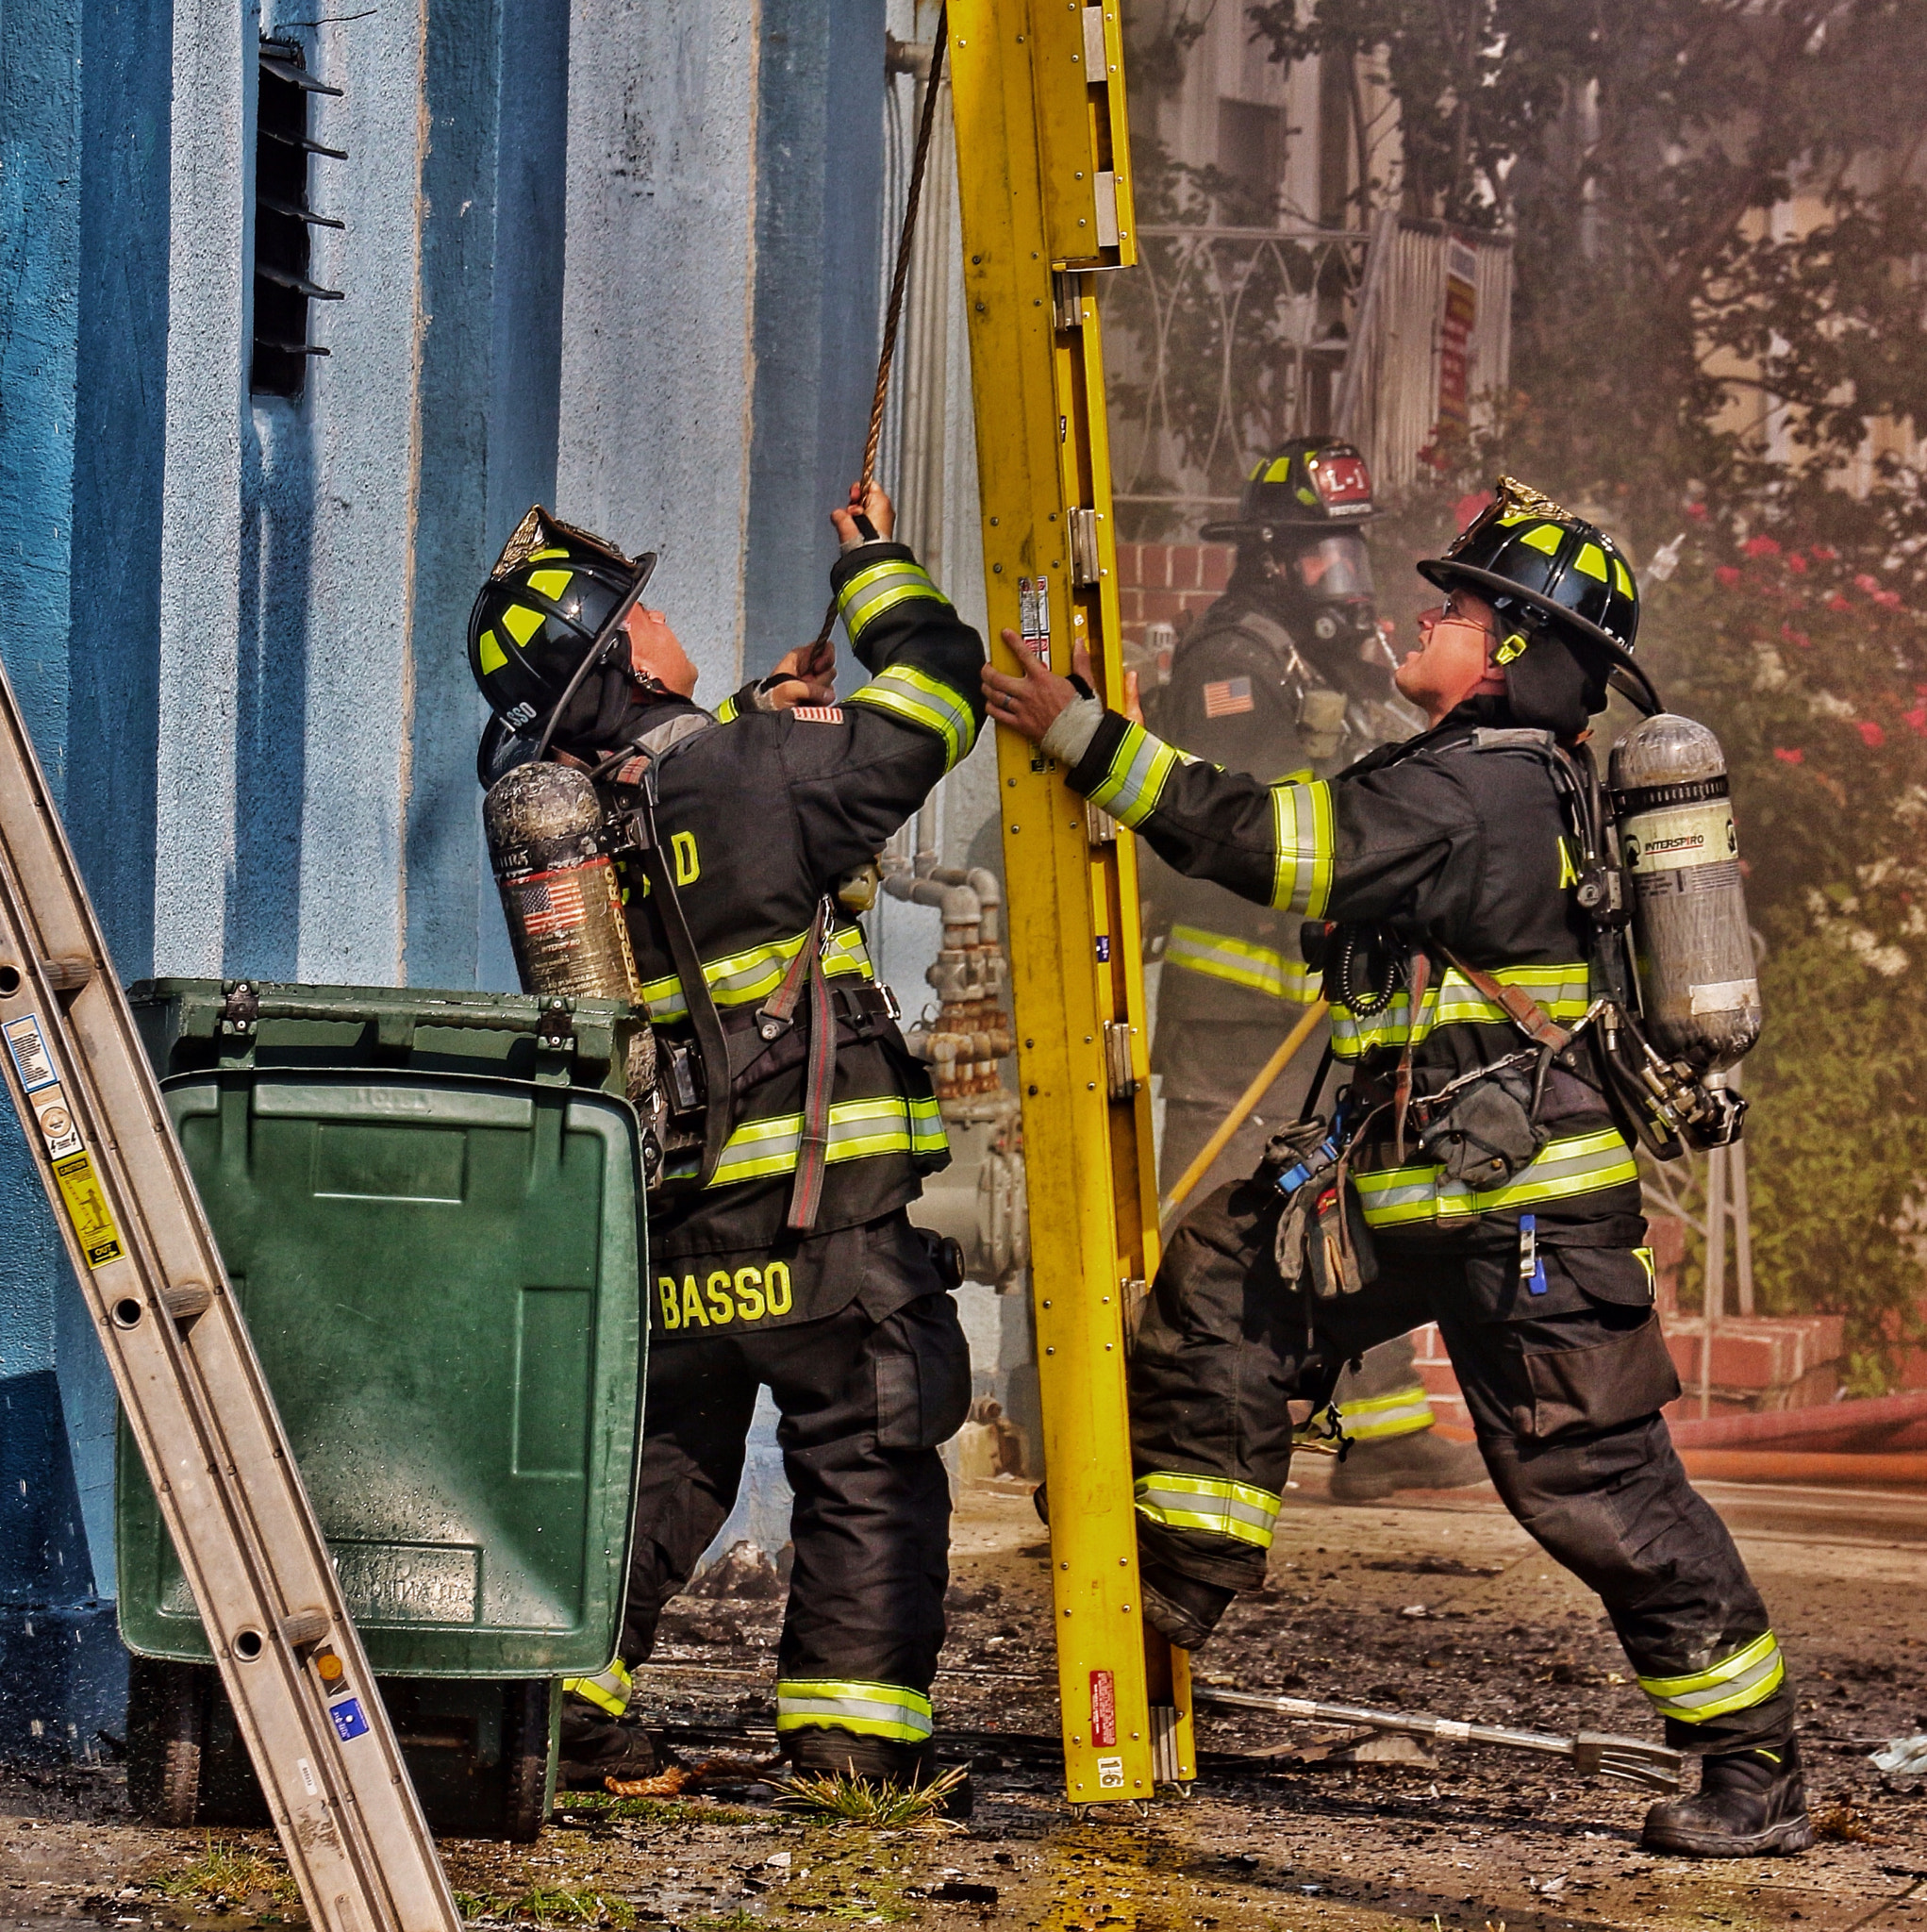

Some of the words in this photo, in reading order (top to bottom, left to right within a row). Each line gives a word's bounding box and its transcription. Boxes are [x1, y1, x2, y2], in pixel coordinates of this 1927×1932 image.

[1326, 469, 1364, 491] L-1
[500, 702, 537, 731] SSO
[1645, 834, 1704, 851] INTERSPIRO
[94, 1244, 113, 1257] OUT
[658, 1260, 793, 1329] BASSO
